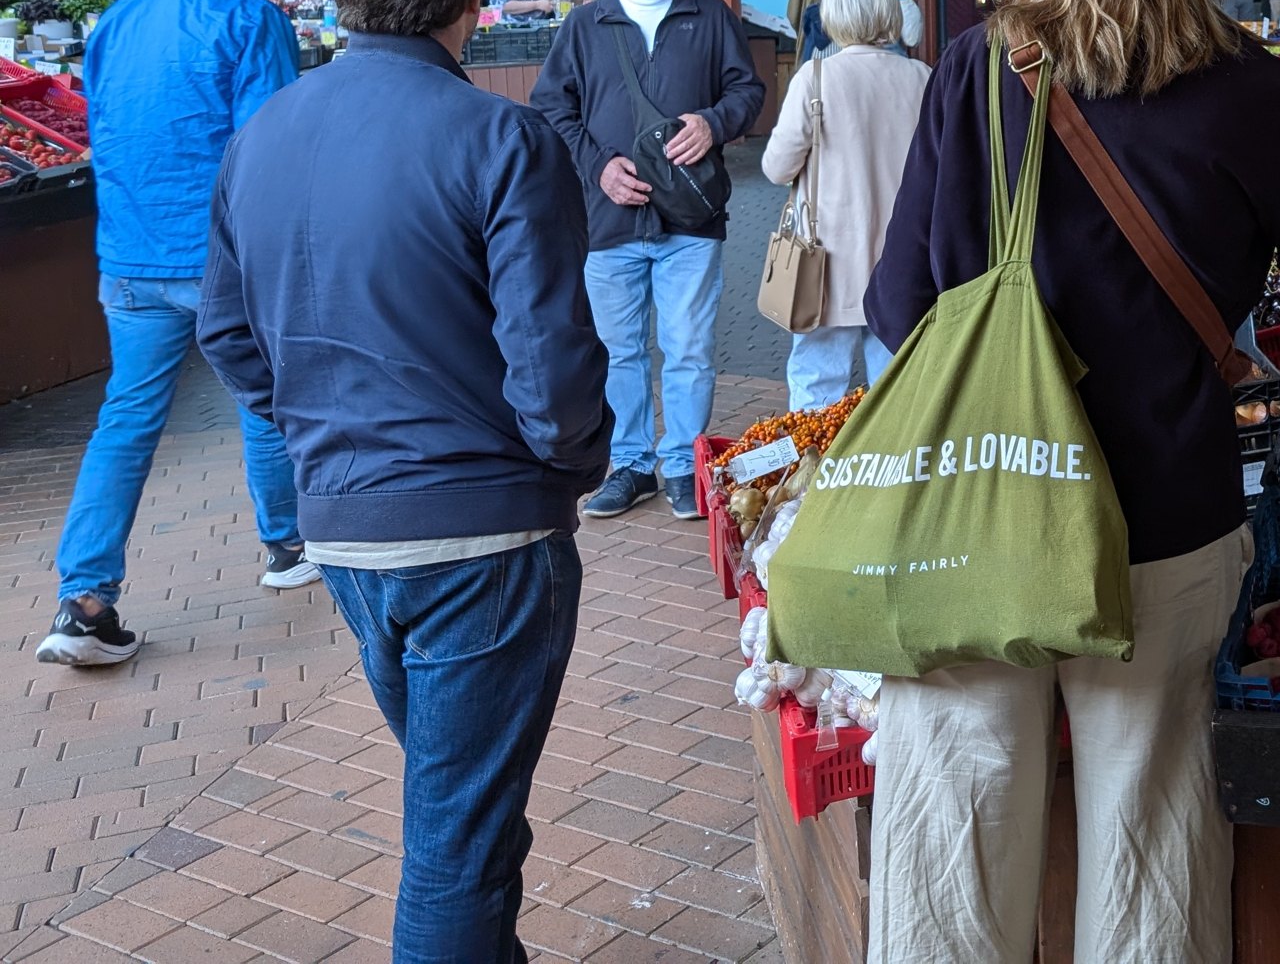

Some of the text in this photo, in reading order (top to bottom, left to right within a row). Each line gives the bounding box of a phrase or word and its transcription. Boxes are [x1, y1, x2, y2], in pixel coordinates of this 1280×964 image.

[938, 439, 958, 477] &
[964, 432, 1091, 480] LOVABLE.
[852, 554, 969, 576] JIMMY FAIRLY
